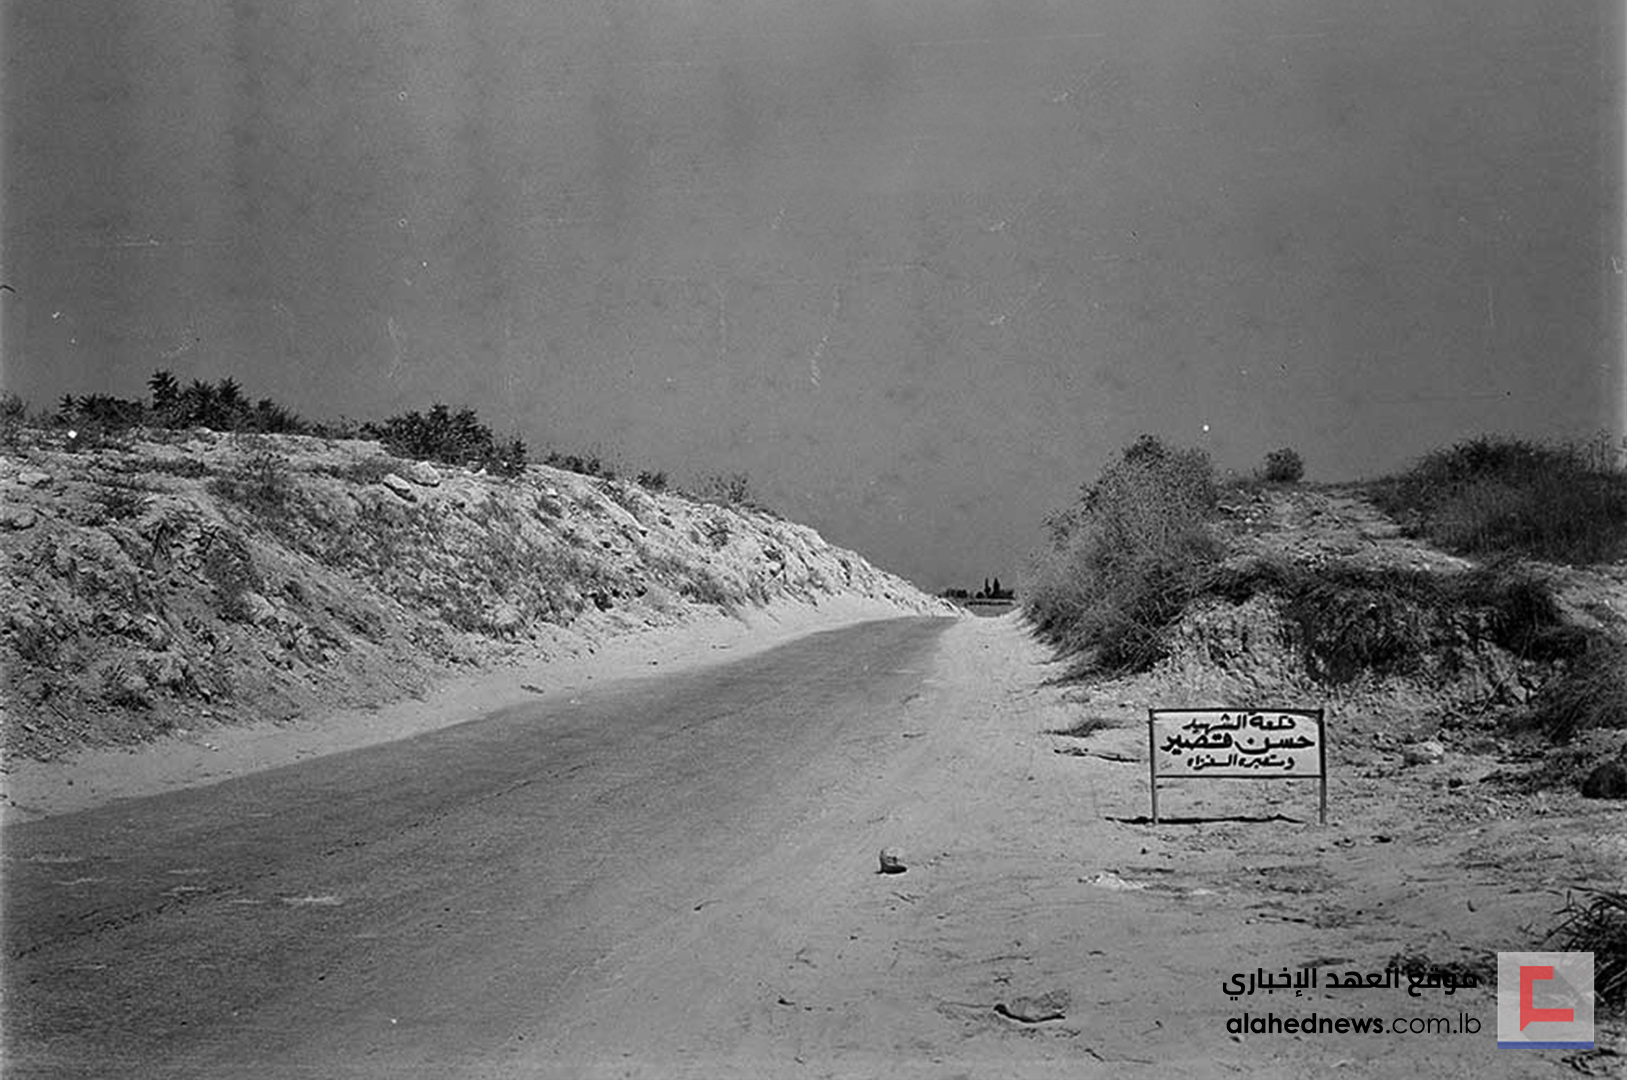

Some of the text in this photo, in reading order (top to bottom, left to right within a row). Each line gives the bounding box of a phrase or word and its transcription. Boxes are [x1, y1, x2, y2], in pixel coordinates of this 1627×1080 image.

[1181, 713, 1249, 734] الشهيد
[1160, 732, 1316, 756] حسن قصير
